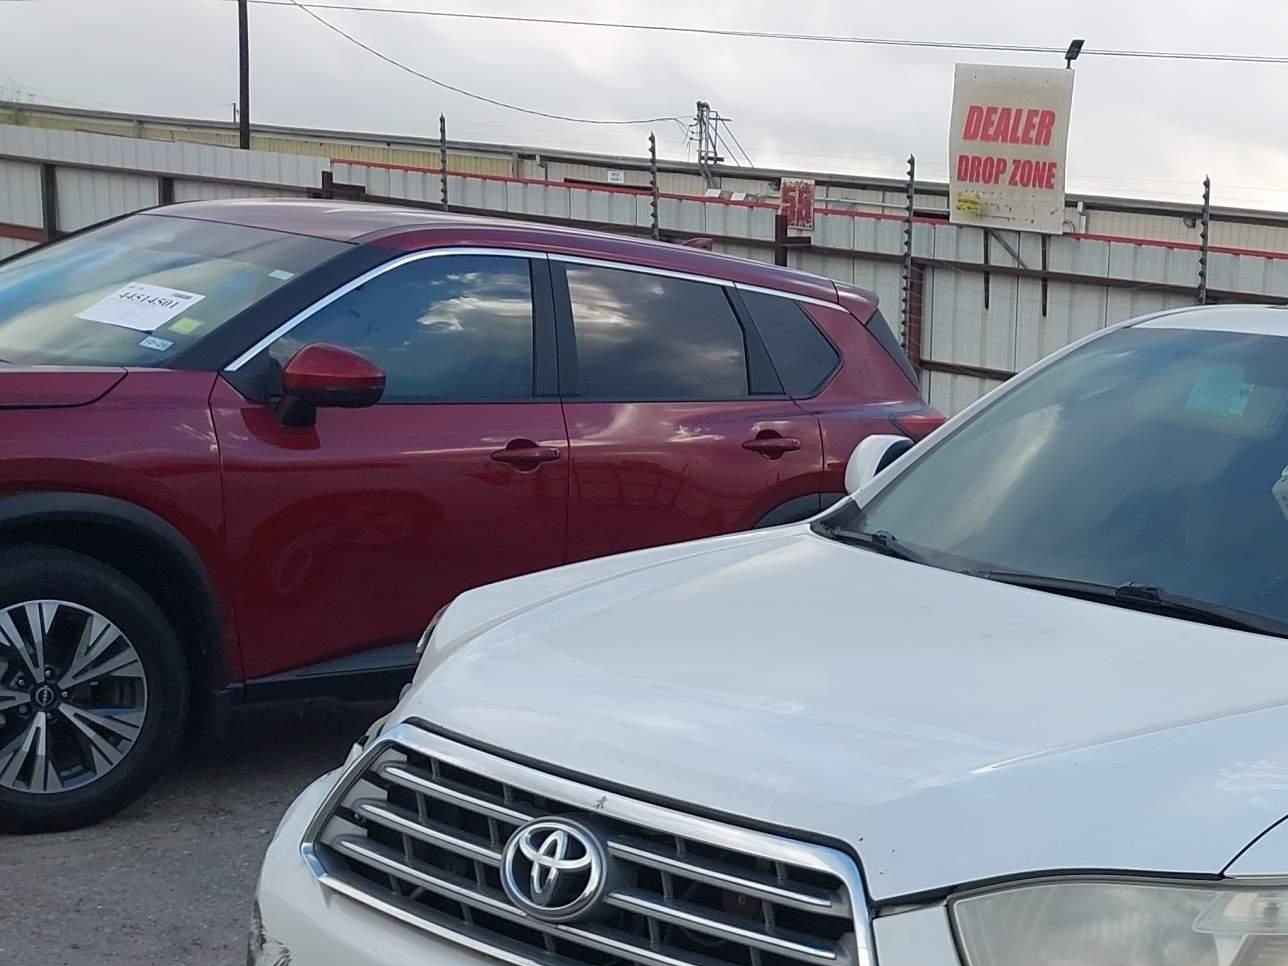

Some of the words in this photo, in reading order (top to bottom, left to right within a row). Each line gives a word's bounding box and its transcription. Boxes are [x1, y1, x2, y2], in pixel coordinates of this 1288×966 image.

[963, 105, 1056, 146] DEALER
[956, 154, 1008, 185] DROP
[1008, 158, 1057, 190] ZONE
